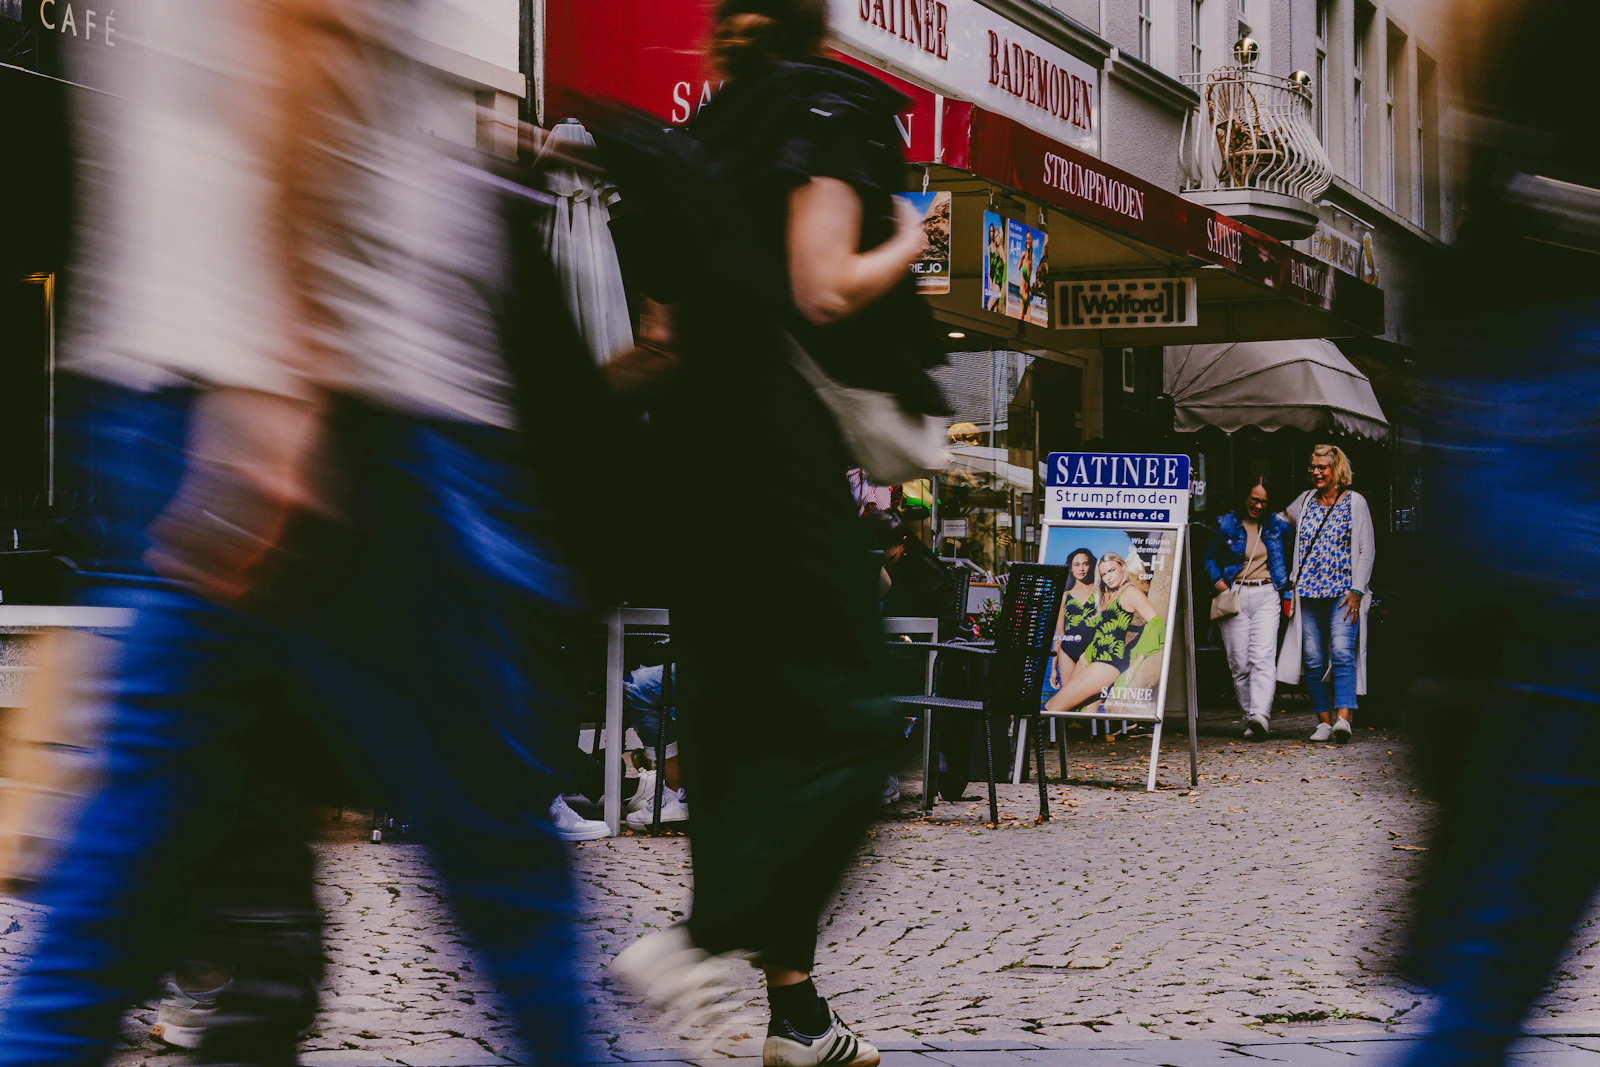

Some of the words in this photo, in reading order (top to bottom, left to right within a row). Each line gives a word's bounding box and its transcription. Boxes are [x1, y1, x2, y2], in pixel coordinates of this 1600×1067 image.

[40, 0, 115, 47] CAFÉ
[987, 29, 1093, 133] BADEMODEN
[1043, 151, 1144, 222] STRUMPFMODEN
[1206, 217, 1243, 265] SATINEE
[1080, 292, 1165, 315] Wolford
[1056, 455, 1179, 487] SATINEE
[1056, 489, 1178, 506] Strumpfmoden
[1067, 509, 1165, 521] www.satinee.de
[1131, 537, 1144, 545] Wir
[1145, 537, 1170, 545] führen
[1100, 685, 1153, 701] SATINEE
